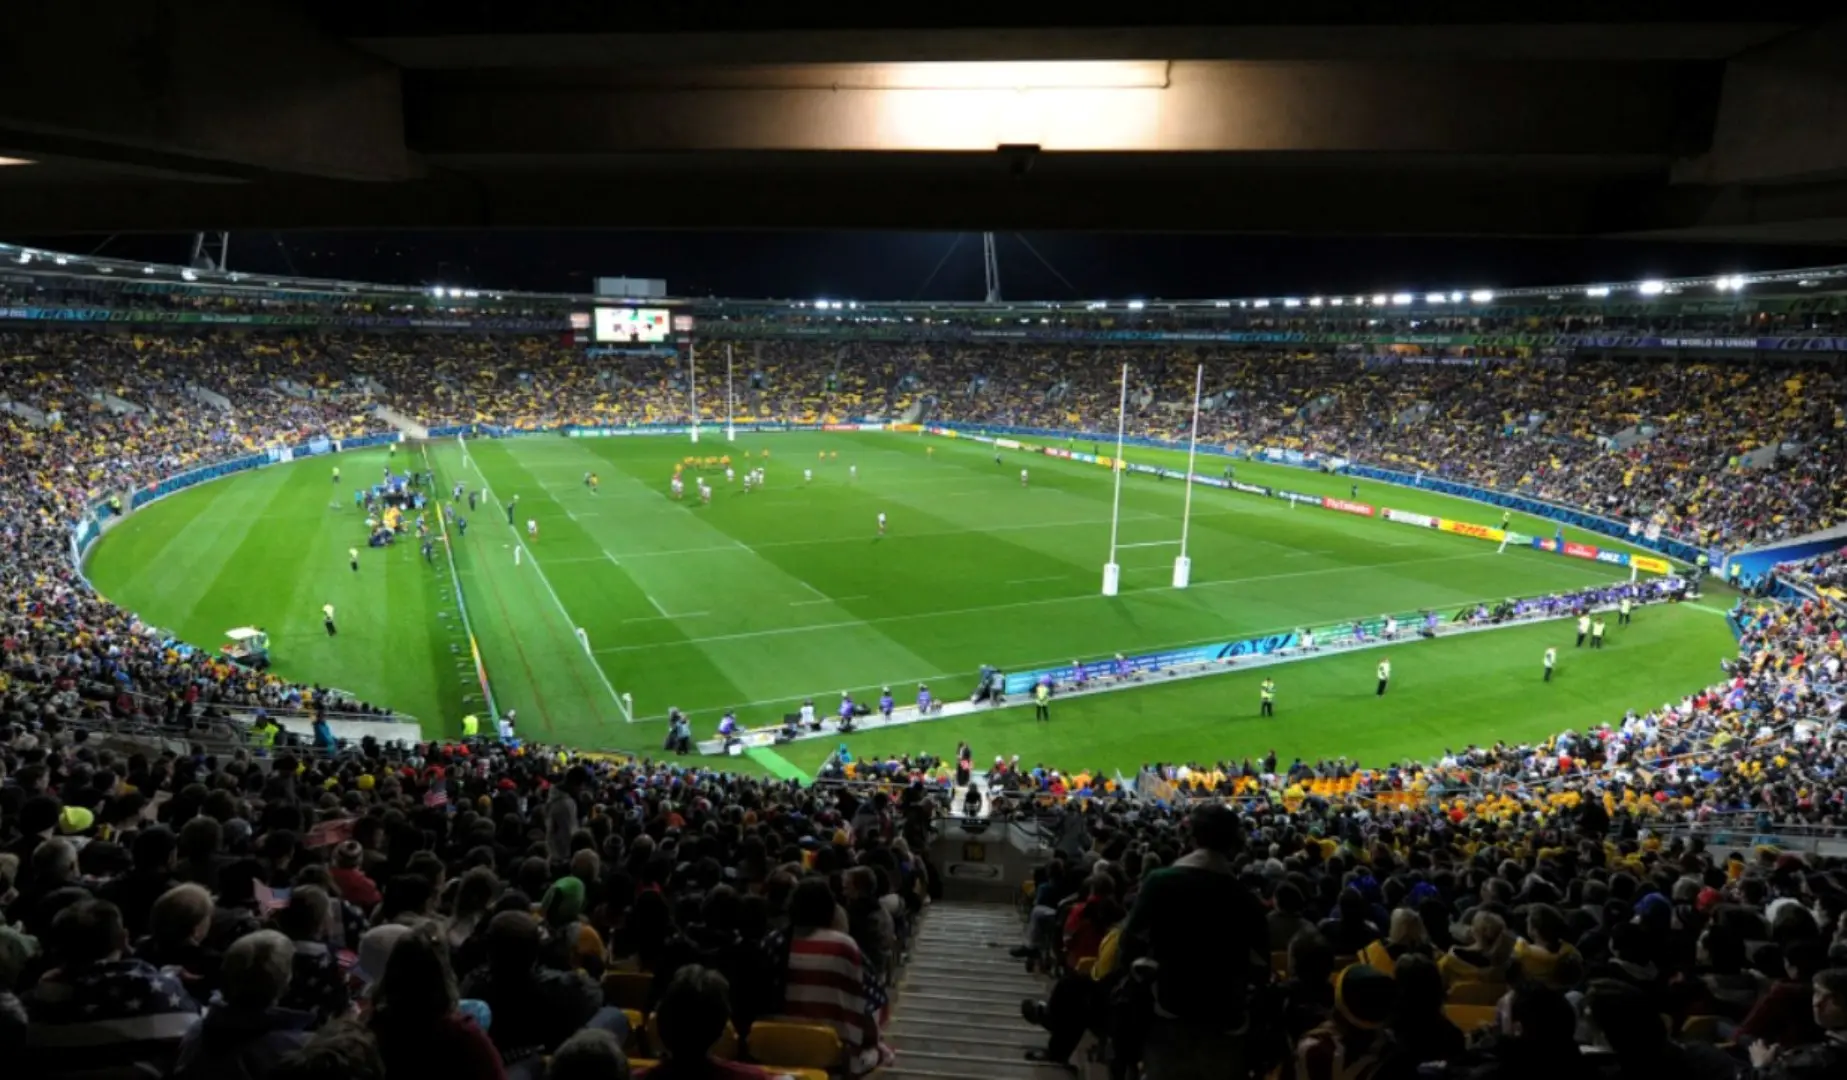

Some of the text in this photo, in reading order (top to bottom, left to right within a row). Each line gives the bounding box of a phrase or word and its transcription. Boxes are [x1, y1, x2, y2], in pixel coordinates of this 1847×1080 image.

[1661, 338, 1757, 347] THE WORLD IN UNION
[1597, 550, 1620, 563] ANZ
